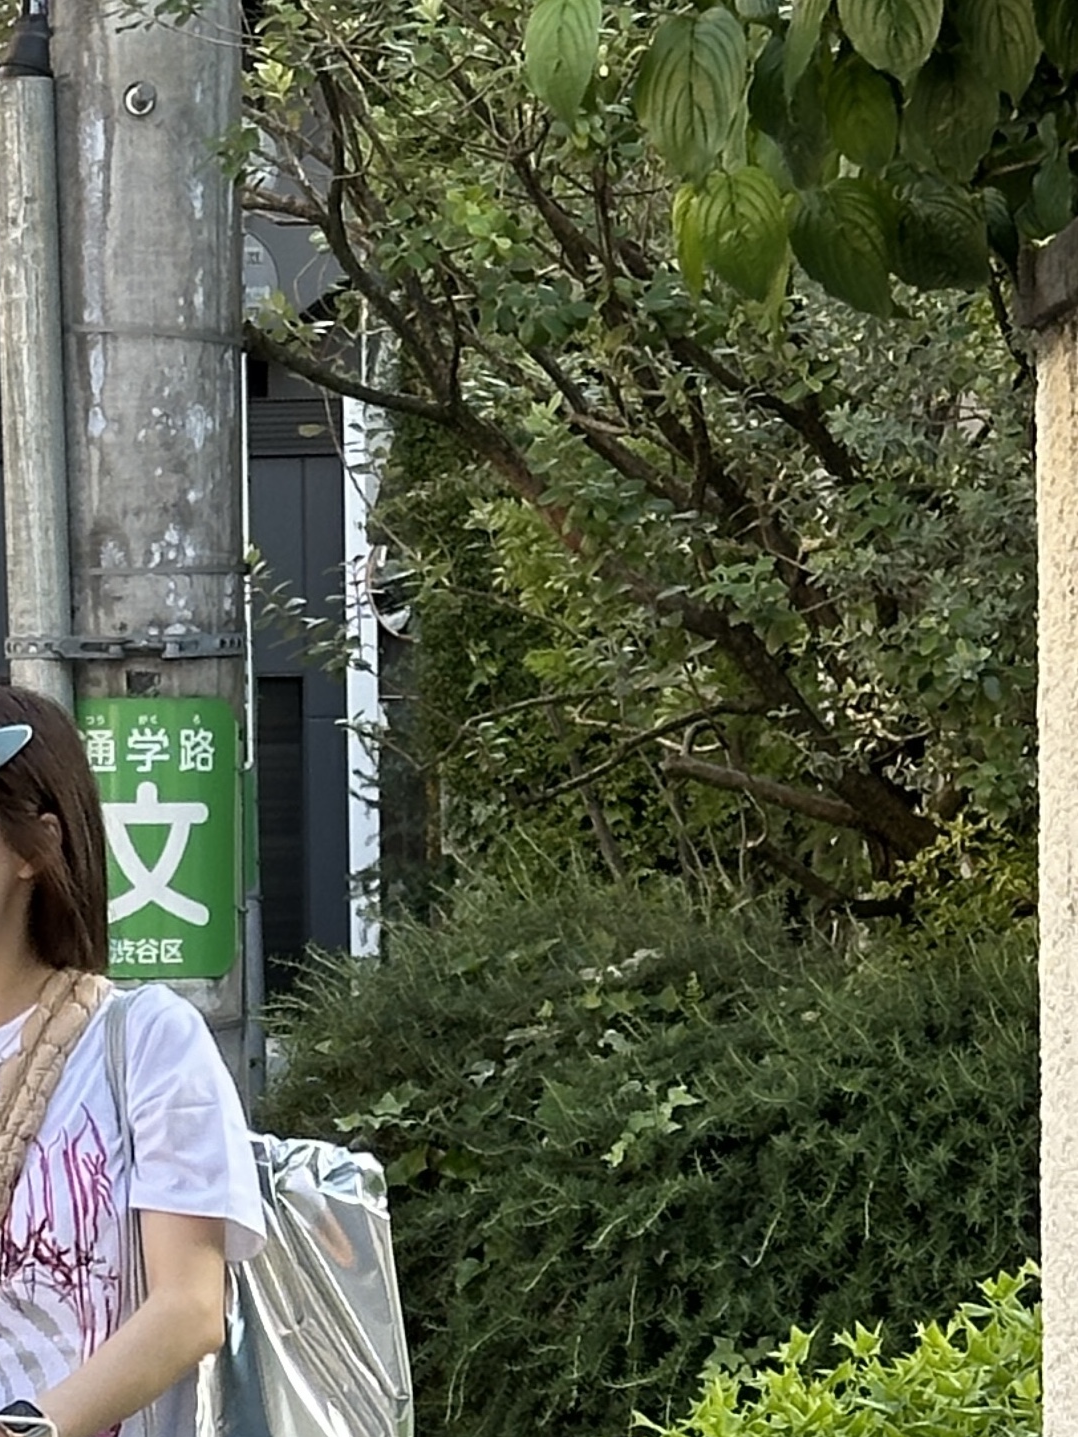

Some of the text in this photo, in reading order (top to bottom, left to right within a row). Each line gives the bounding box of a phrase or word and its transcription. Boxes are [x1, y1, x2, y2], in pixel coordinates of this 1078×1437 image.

[78, 728, 215, 772] 通学路
[109, 938, 184, 964] 渋谷区
